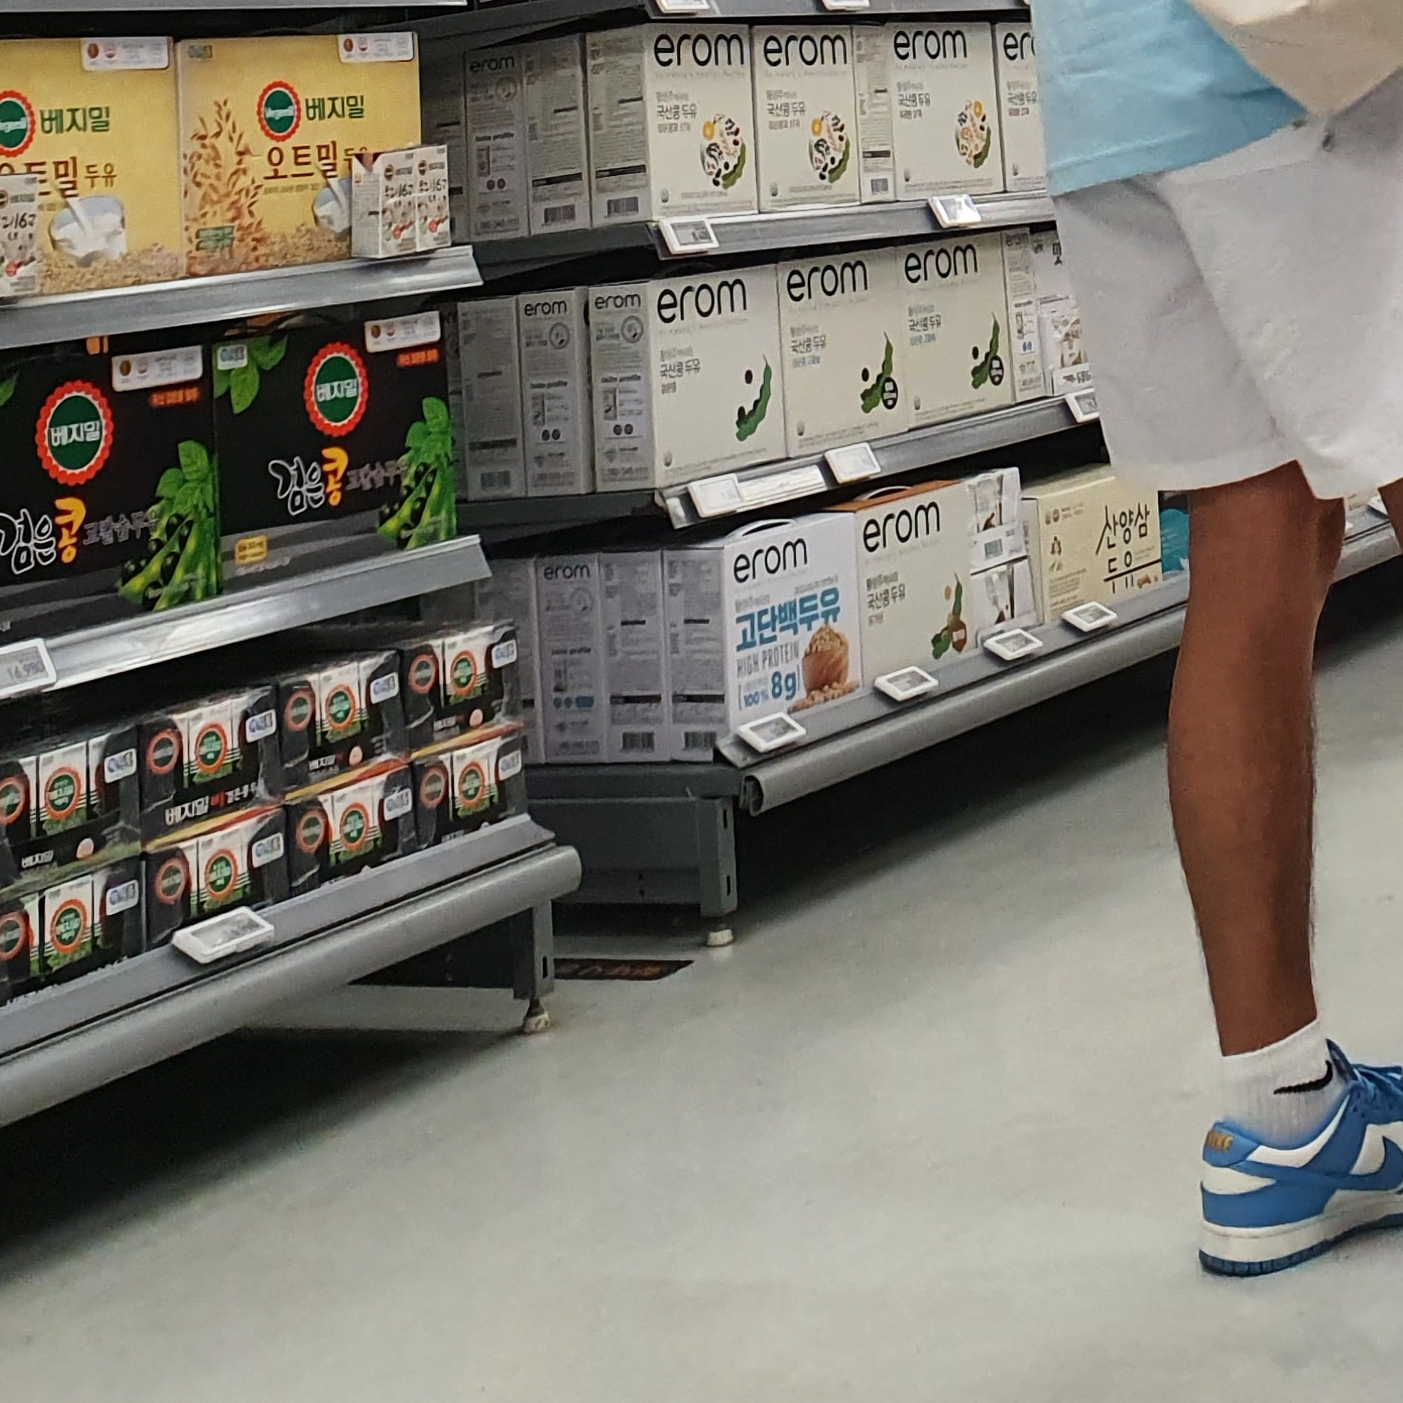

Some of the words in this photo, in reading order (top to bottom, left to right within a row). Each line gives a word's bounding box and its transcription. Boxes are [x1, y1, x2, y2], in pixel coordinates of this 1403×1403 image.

[654, 33, 744, 67] erom
[764, 34, 847, 67] erom
[894, 30, 967, 61] erom
[469, 55, 515, 73] erom
[40, 106, 110, 134] 베지밀
[305, 96, 364, 121] 베지밀
[657, 104, 680, 120] 국산콩
[682, 103, 698, 119] 두유
[767, 102, 790, 117] 국산콩
[791, 101, 806, 116] 두유
[263, 140, 338, 180] 오트밀
[85, 163, 117, 188] 두유
[905, 244, 978, 283] erom
[787, 260, 868, 302] erom
[524, 300, 567, 316] erom
[595, 293, 641, 309] erom
[657, 279, 747, 323] erom
[813, 335, 827, 351] 두유
[685, 358, 701, 374] 두유
[316, 378, 358, 402] 베지밀
[50, 421, 100, 447] 베지밀
[268, 446, 349, 516] 검은콩
[863, 501, 940, 552] erom
[1095, 502, 1150, 556] 산양삼
[543, 564, 590, 580] erom
[734, 538, 807, 583] erom
[736, 654, 759, 678] HIGH
[762, 641, 799, 668] PROTEIN
